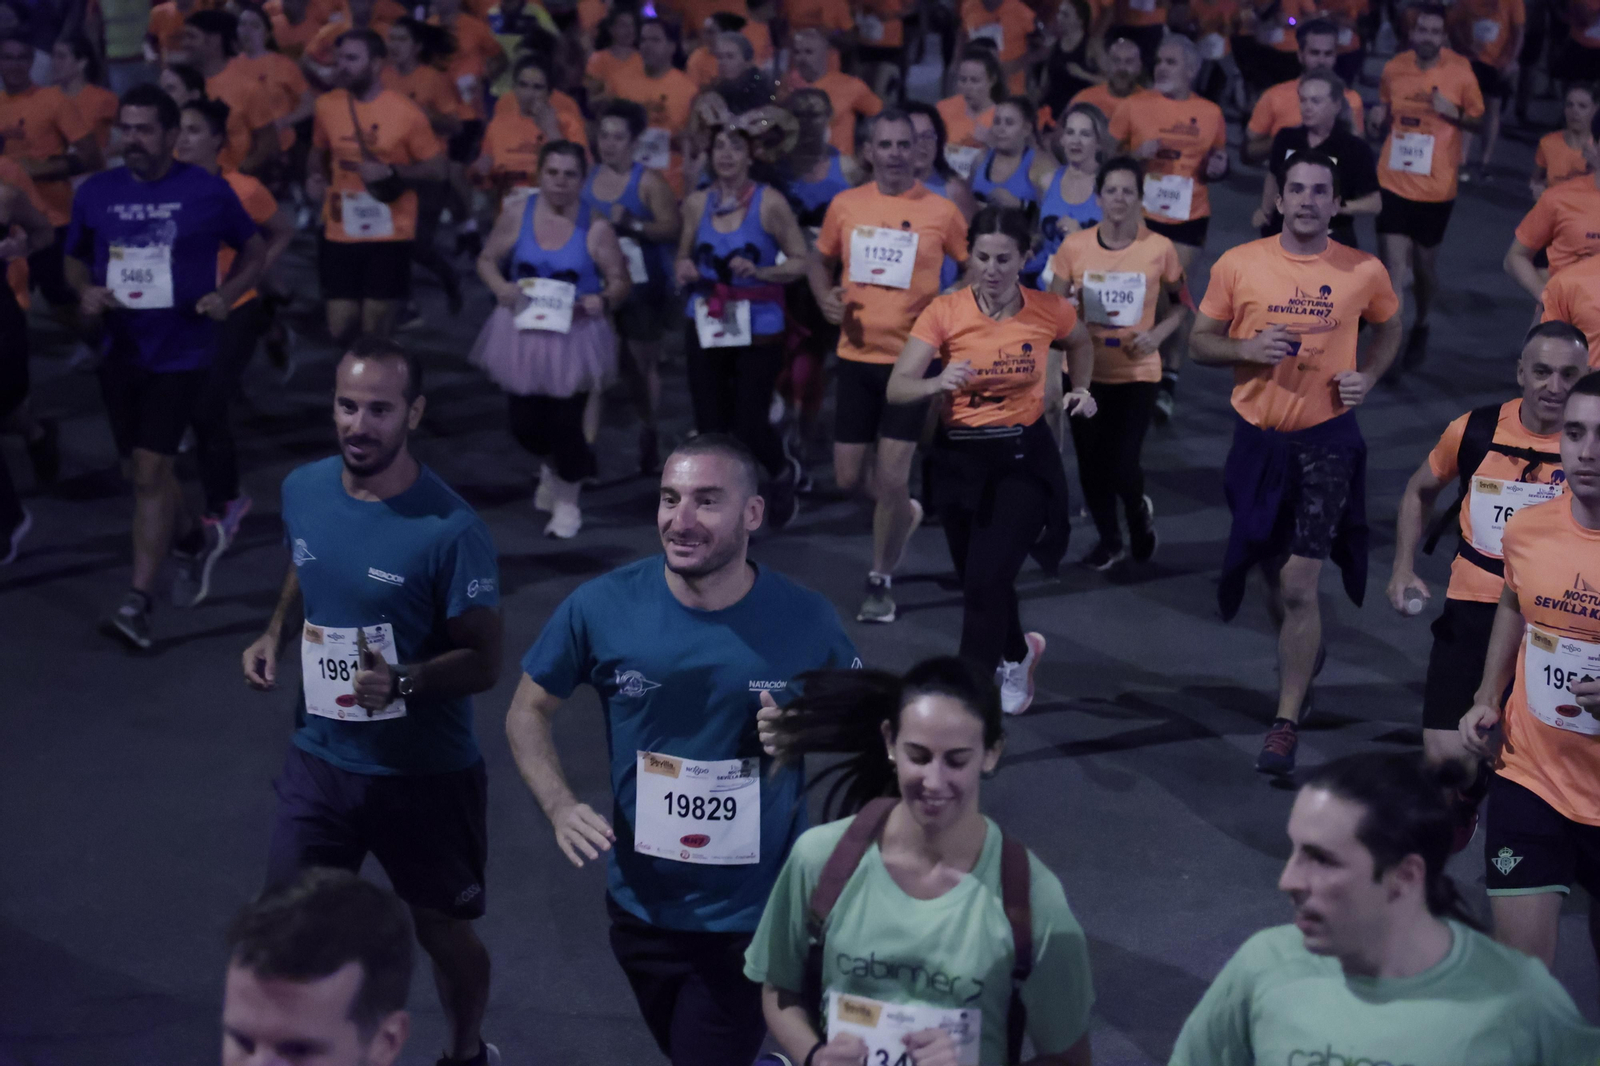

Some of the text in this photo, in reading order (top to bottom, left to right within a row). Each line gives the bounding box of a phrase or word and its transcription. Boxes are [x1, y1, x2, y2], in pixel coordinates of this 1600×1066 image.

[865, 244, 903, 263] 11322
[1098, 289, 1134, 304] 11296
[1267, 304, 1307, 315] SEVILLA
[1288, 298, 1334, 309] NOCTURNA
[993, 358, 1036, 367] NOCTURNA
[1534, 595, 1588, 617] SEVILLA
[749, 680, 787, 689] NATACIÓN
[664, 791, 737, 821] 19829
